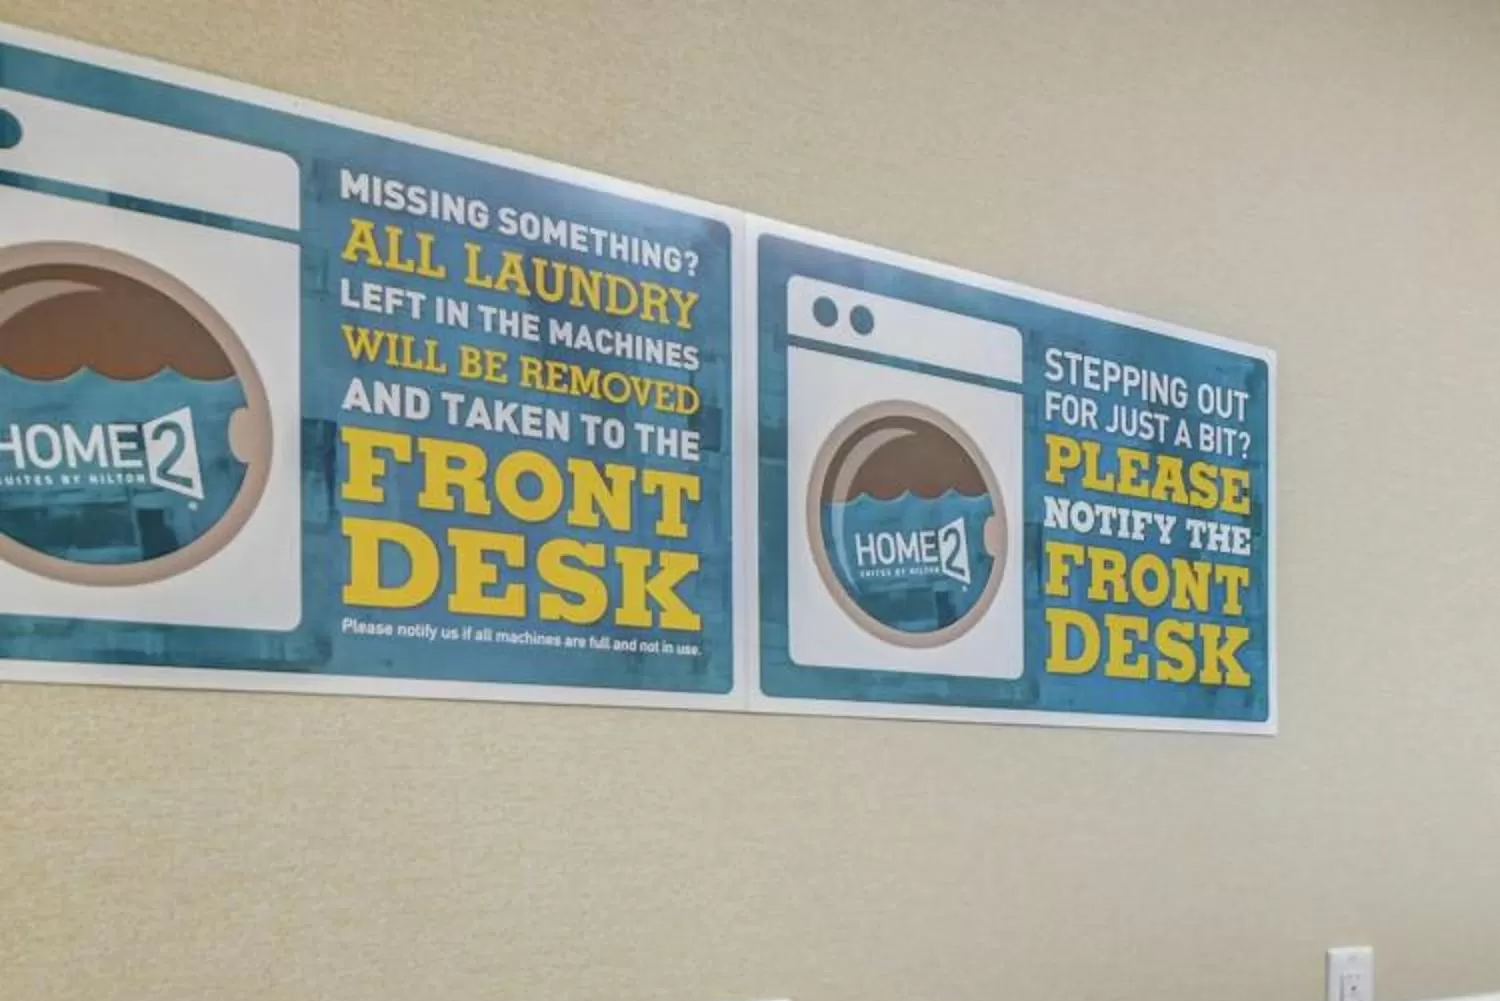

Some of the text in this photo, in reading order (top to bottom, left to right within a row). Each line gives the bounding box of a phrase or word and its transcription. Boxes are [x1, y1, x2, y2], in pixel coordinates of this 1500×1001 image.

[340, 168, 700, 278] MISSING SOMETHING?
[341, 217, 699, 329] ALL LAUNDRY
[340, 277, 700, 372] LEFT IN THE MACHINES
[340, 323, 701, 415] WILL BE REMOVED
[1044, 347, 1250, 423] STEPPING OUT
[342, 377, 700, 462] AND TAKEN TO THE
[1045, 389, 1251, 460] FOR JUST A BIT?
[340, 425, 701, 538] FRONT
[1045, 433, 1250, 515] PLEASE
[1043, 495, 1251, 556] NOTIFY THE
[341, 516, 702, 631] DESK
[1044, 541, 1250, 617] FRONT
[341, 617, 394, 637] Please
[397, 622, 438, 642] notify
[440, 627, 460, 641] us
[461, 626, 474, 642] if
[475, 628, 493, 643] all
[495, 630, 562, 647] machines
[564, 634, 587, 649] are
[588, 635, 611, 651] full
[613, 637, 637, 652] and
[639, 640, 660, 654] not
[661, 641, 674, 655] in
[1045, 607, 1251, 687] DESK
